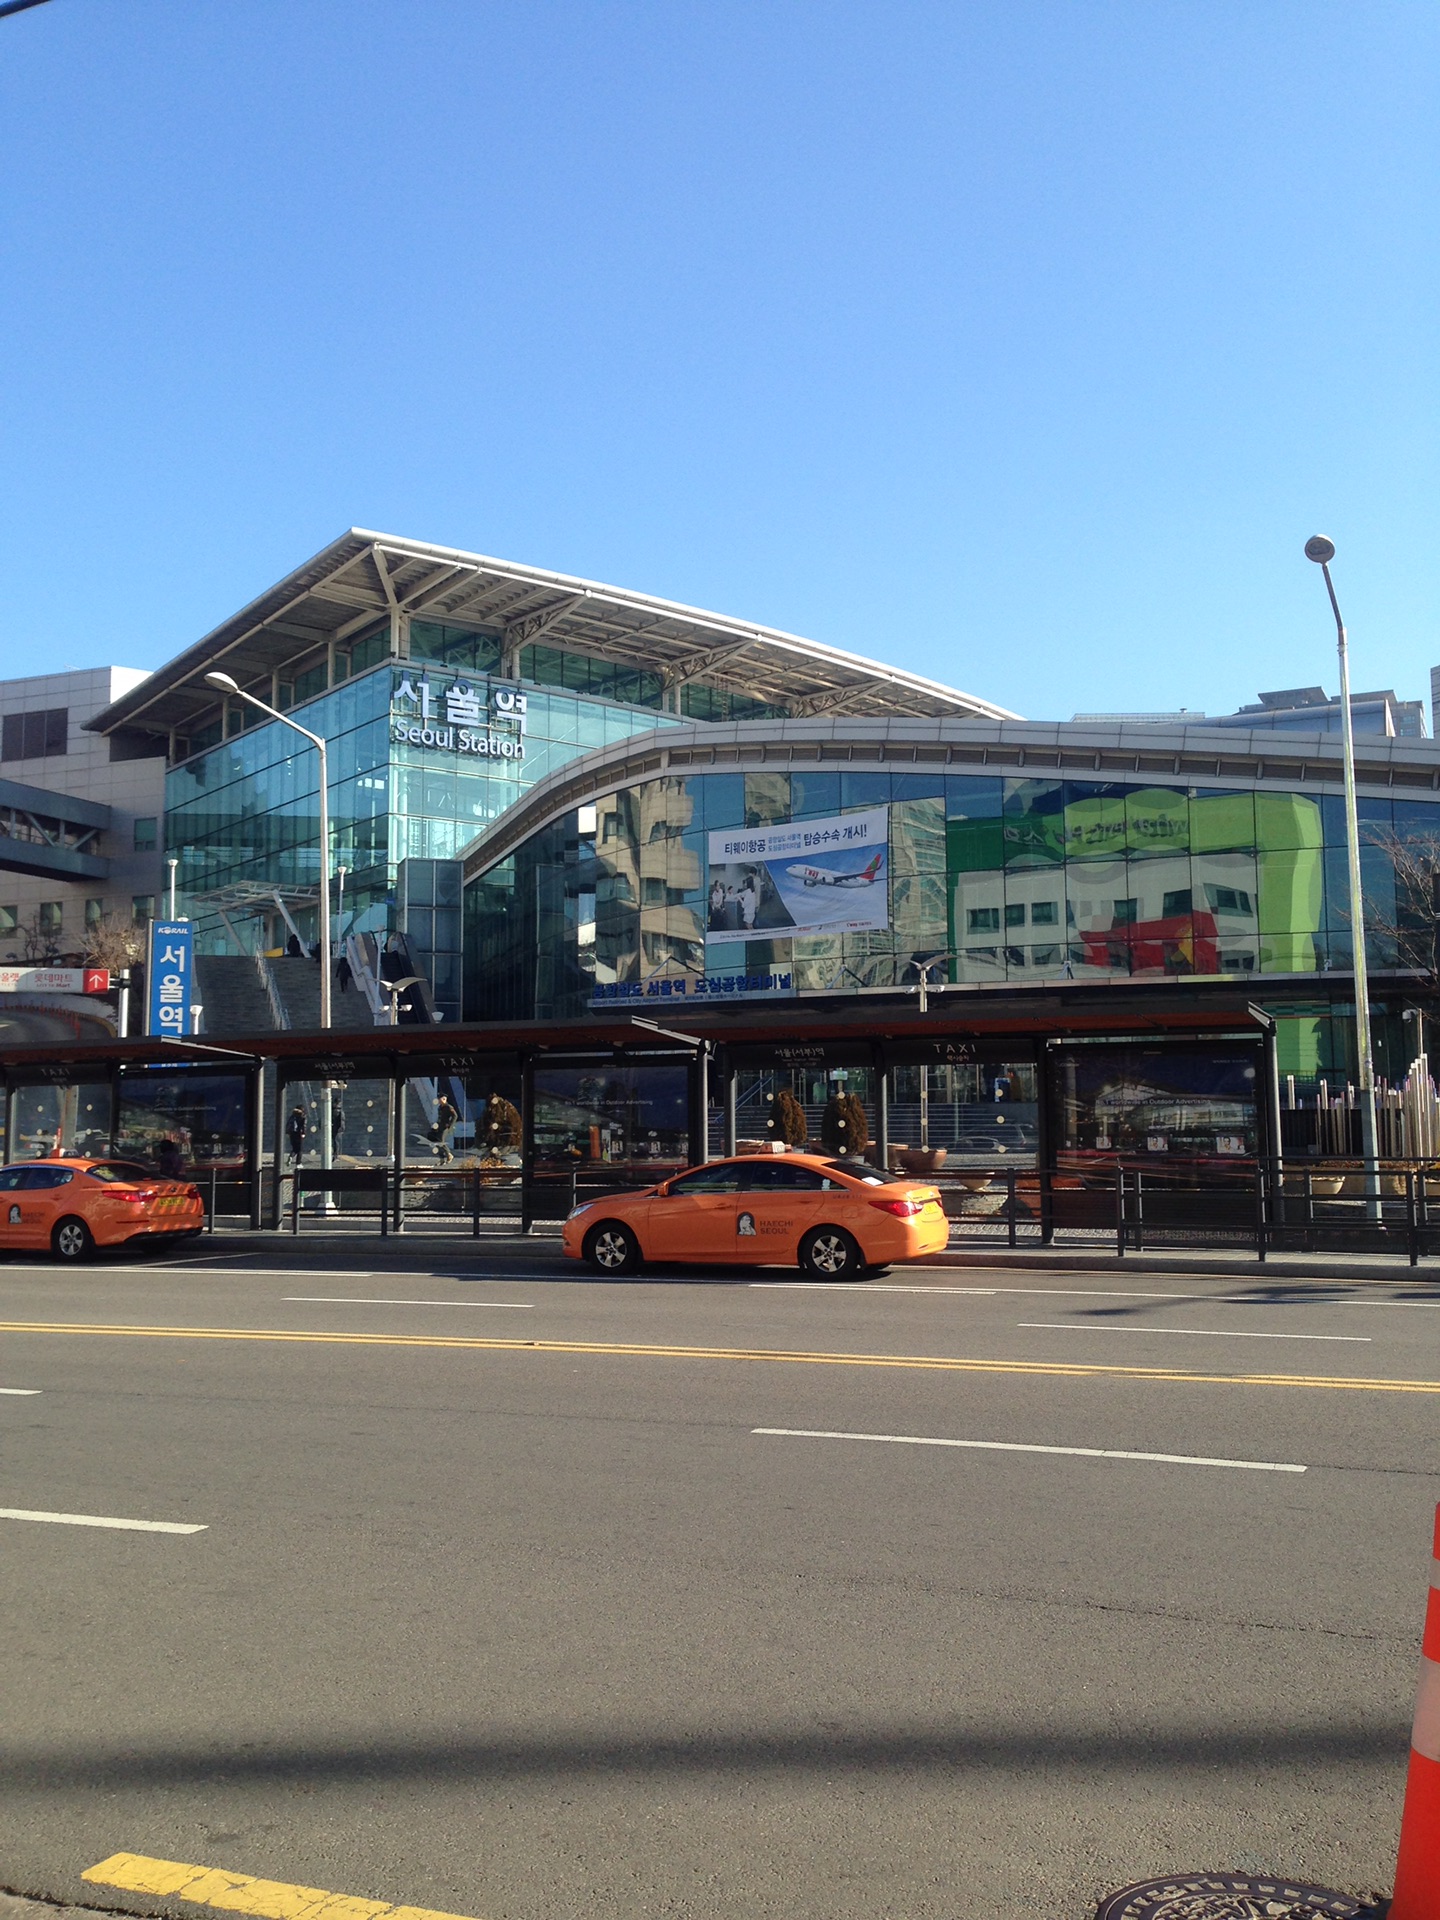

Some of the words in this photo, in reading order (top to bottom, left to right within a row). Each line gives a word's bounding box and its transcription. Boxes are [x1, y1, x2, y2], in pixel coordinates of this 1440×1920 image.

[394, 670, 528, 735] 서울역
[396, 720, 453, 750] Seoul
[459, 730, 525, 759] Station
[803, 830, 841, 847] 탑승수속
[842, 824, 867, 839] 개시!
[724, 839, 766, 855] 티웨이항공
[157, 926, 189, 935] KORAIL
[0, 972, 20, 982] 울렛
[34, 973, 73, 982] 롯데마트
[158, 944, 185, 1034] 서울역
[647, 979, 686, 996] 서울역
[695, 973, 792, 993] 도심공항터미널
[933, 1043, 976, 1053] TAXI
[439, 1057, 475, 1067] TAXI
[1176, 1098, 1212, 1106] Advertising
[759, 1227, 790, 1235] SEOUL
